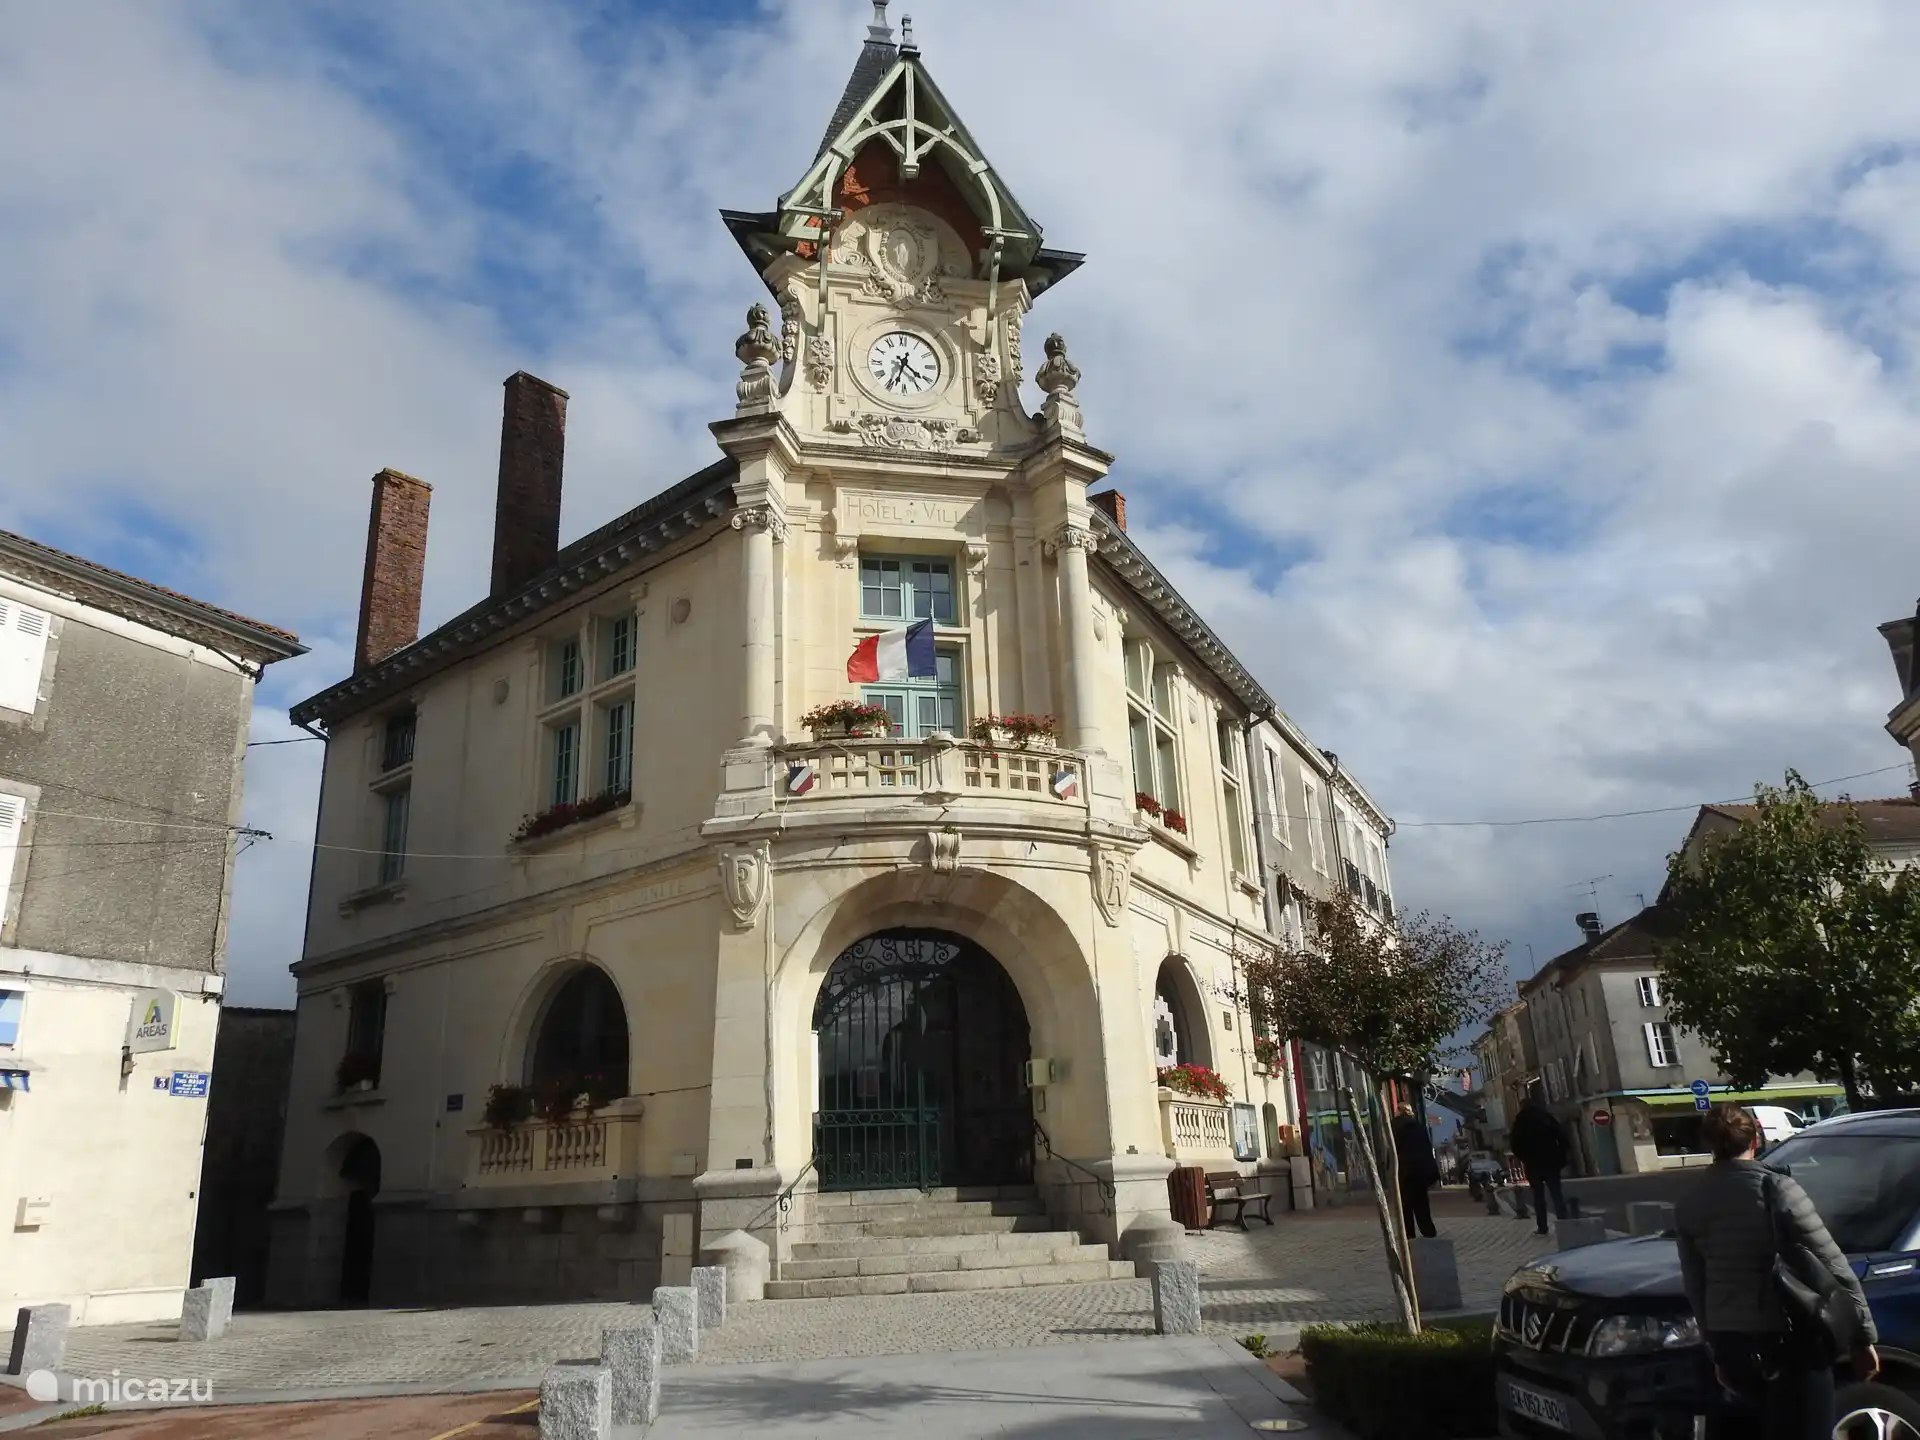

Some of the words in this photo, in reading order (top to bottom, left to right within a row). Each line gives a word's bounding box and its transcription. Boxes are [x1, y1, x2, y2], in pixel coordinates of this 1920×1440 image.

[922, 502, 974, 524] VILLE
[136, 1023, 167, 1039] AREAS
[159, 1078, 166, 1088] 3
[1699, 1099, 1706, 1108] P
